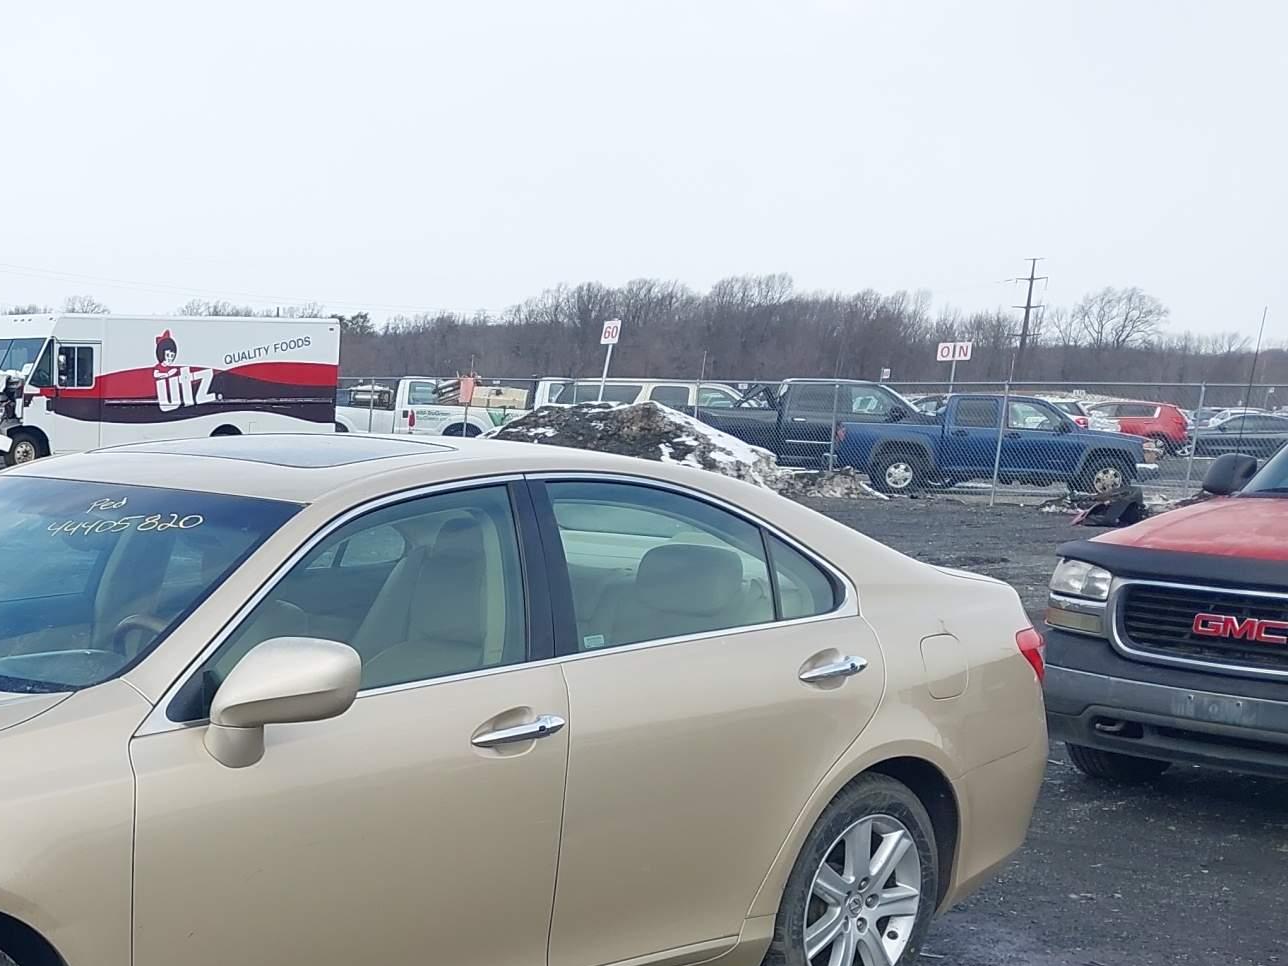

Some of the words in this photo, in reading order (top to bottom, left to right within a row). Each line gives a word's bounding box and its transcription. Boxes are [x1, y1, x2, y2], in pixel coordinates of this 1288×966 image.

[603, 325, 619, 340] 60
[224, 345, 270, 365] QUALITY
[273, 336, 311, 353] FOODS
[1193, 612, 1288, 644] GMC
